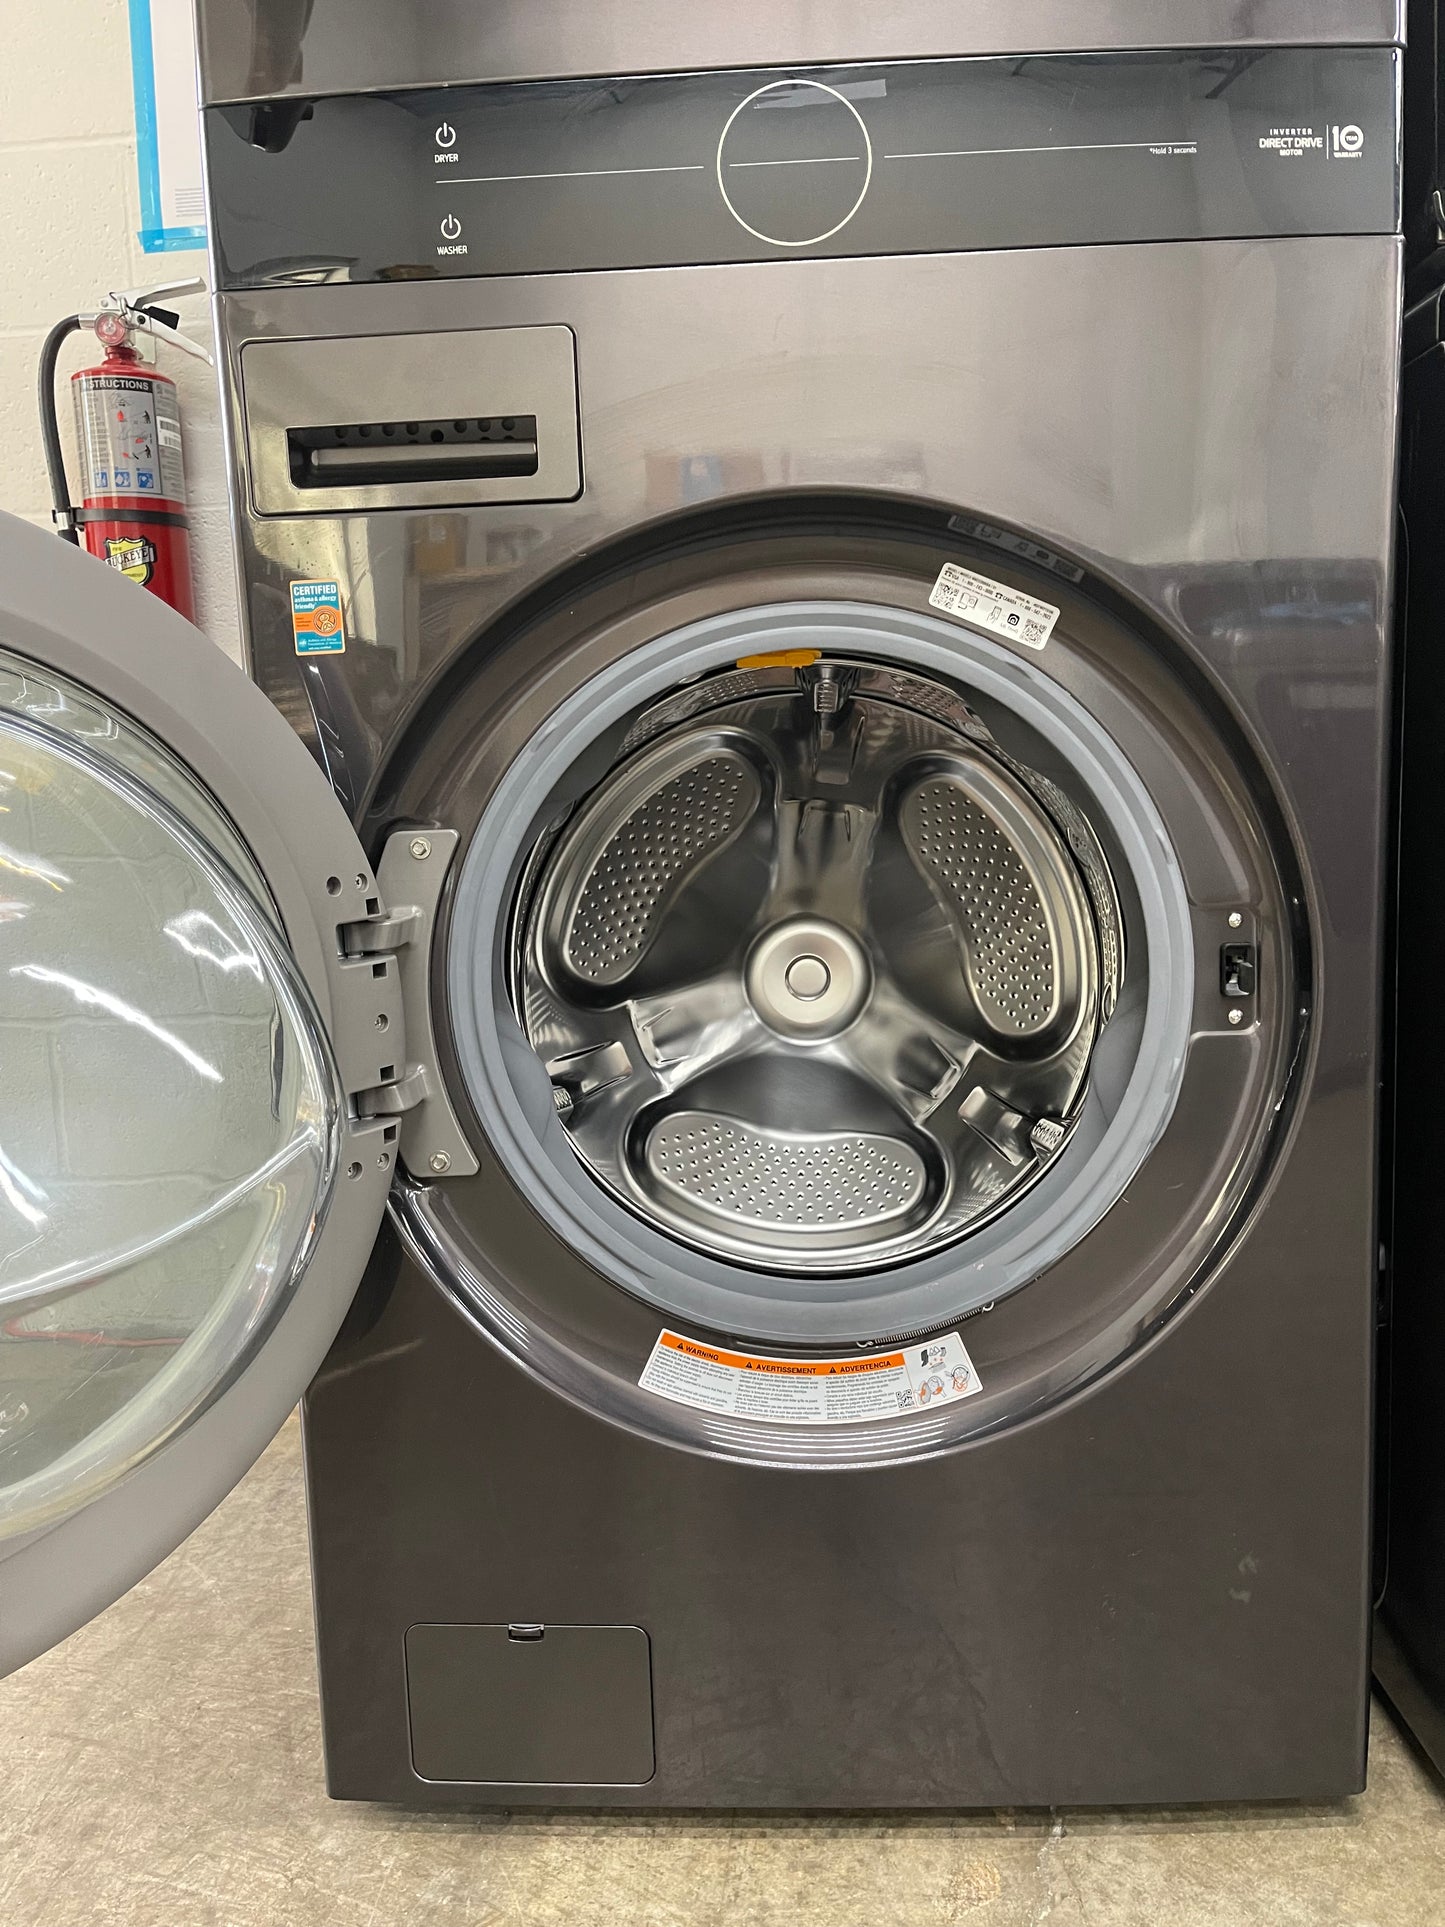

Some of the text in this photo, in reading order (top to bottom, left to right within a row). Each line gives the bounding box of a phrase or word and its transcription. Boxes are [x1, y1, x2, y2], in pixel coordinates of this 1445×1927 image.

[1269, 128, 1313, 136] INVERTER
[1259, 136, 1324, 149] DIRECT DRIVE
[1332, 125, 1364, 151] 10
[1167, 146, 1173, 154] 3
[1173, 146, 1198, 154] seconds
[434, 153, 459, 163] DRYER
[436, 245, 468, 255] WASHER
[293, 584, 337, 596] CERTIFIED
[686, 1345, 719, 1360] WARNING
[756, 1364, 817, 1374] AVERTISSEMENT
[840, 1360, 892, 1373] ADVERTENCIA
